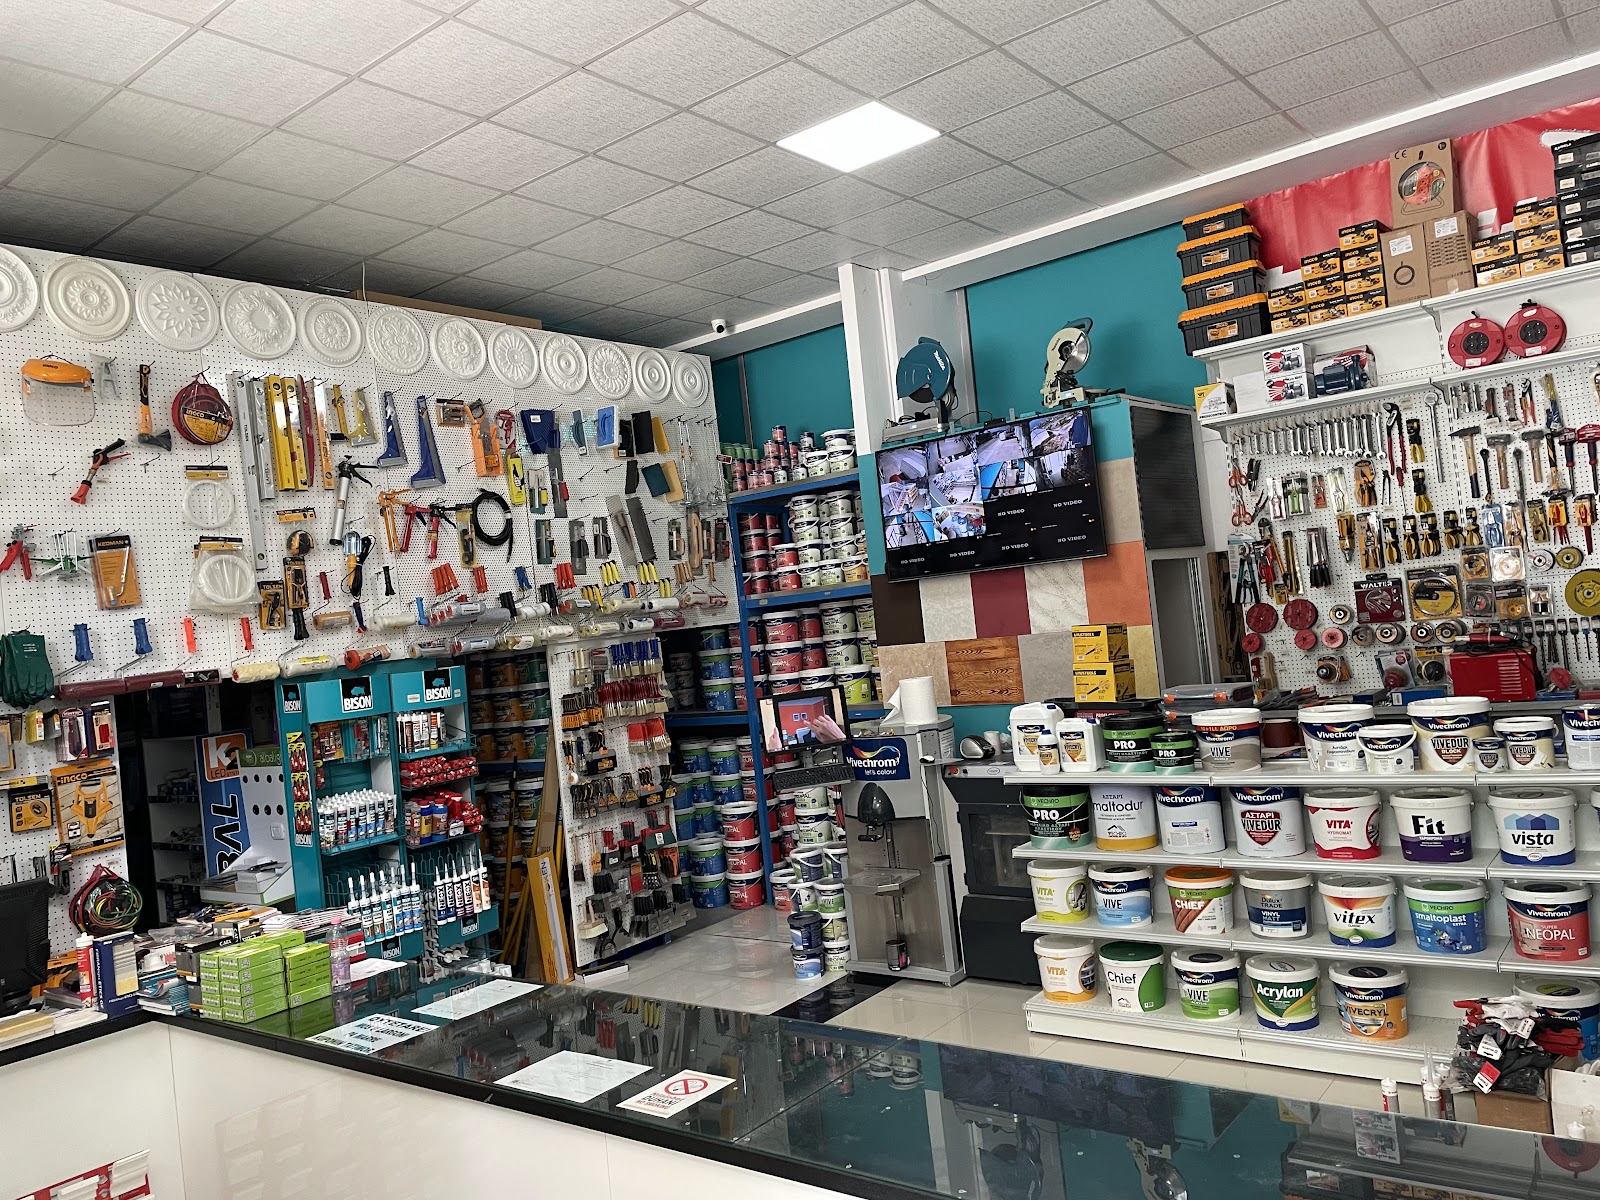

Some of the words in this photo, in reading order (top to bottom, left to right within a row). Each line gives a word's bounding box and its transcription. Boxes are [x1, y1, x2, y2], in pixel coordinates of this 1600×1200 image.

[1063, 499, 1083, 507] VIDEO
[1067, 534, 1087, 542] VIDEO
[1360, 581, 1393, 589] WALTER
[425, 687, 451, 701] BISON
[284, 700, 301, 712] BISON
[343, 695, 372, 711] BISON
[1427, 722, 1468, 730] Vivechrom
[1114, 740, 1136, 750] PRO
[1431, 737, 1470, 750] VIVEDUR
[1210, 747, 1231, 757] VIVE
[846, 756, 897, 768] Vivechrom
[211, 768, 226, 779] LED
[877, 768, 897, 776] colour
[15, 794, 41, 802] TOLSEN
[1157, 793, 1201, 803] Vivechrom
[1236, 792, 1282, 801] Vivechrom
[1093, 800, 1143, 812] maltodur
[1033, 809, 1060, 820] PRO
[1245, 811, 1274, 820] ΑΣΤΑΡΙ
[1241, 819, 1282, 831] VIVEDUR
[1326, 820, 1351, 829] VITA
[1411, 815, 1446, 835] Fit
[295, 834, 312, 846] BISON
[1511, 831, 1554, 845] vista
[1036, 887, 1054, 896] VITA
[1103, 898, 1123, 910] VIVE
[1175, 899, 1205, 910] CHIEF
[1333, 911, 1376, 925] vitex
[1414, 912, 1467, 925] smaltoplast
[1527, 909, 1569, 917] Vivechrom
[463, 923, 478, 934] BISON
[1526, 928, 1575, 941] NEOPAL
[383, 947, 400, 959] BISON
[1047, 966, 1066, 976] VITA
[1107, 971, 1137, 984] Chief
[1187, 990, 1209, 1001] VIVE
[1256, 983, 1304, 1000] Acrylan
[1345, 991, 1381, 1001] Vivechrom
[1344, 1005, 1389, 1017] VIVECRYL
